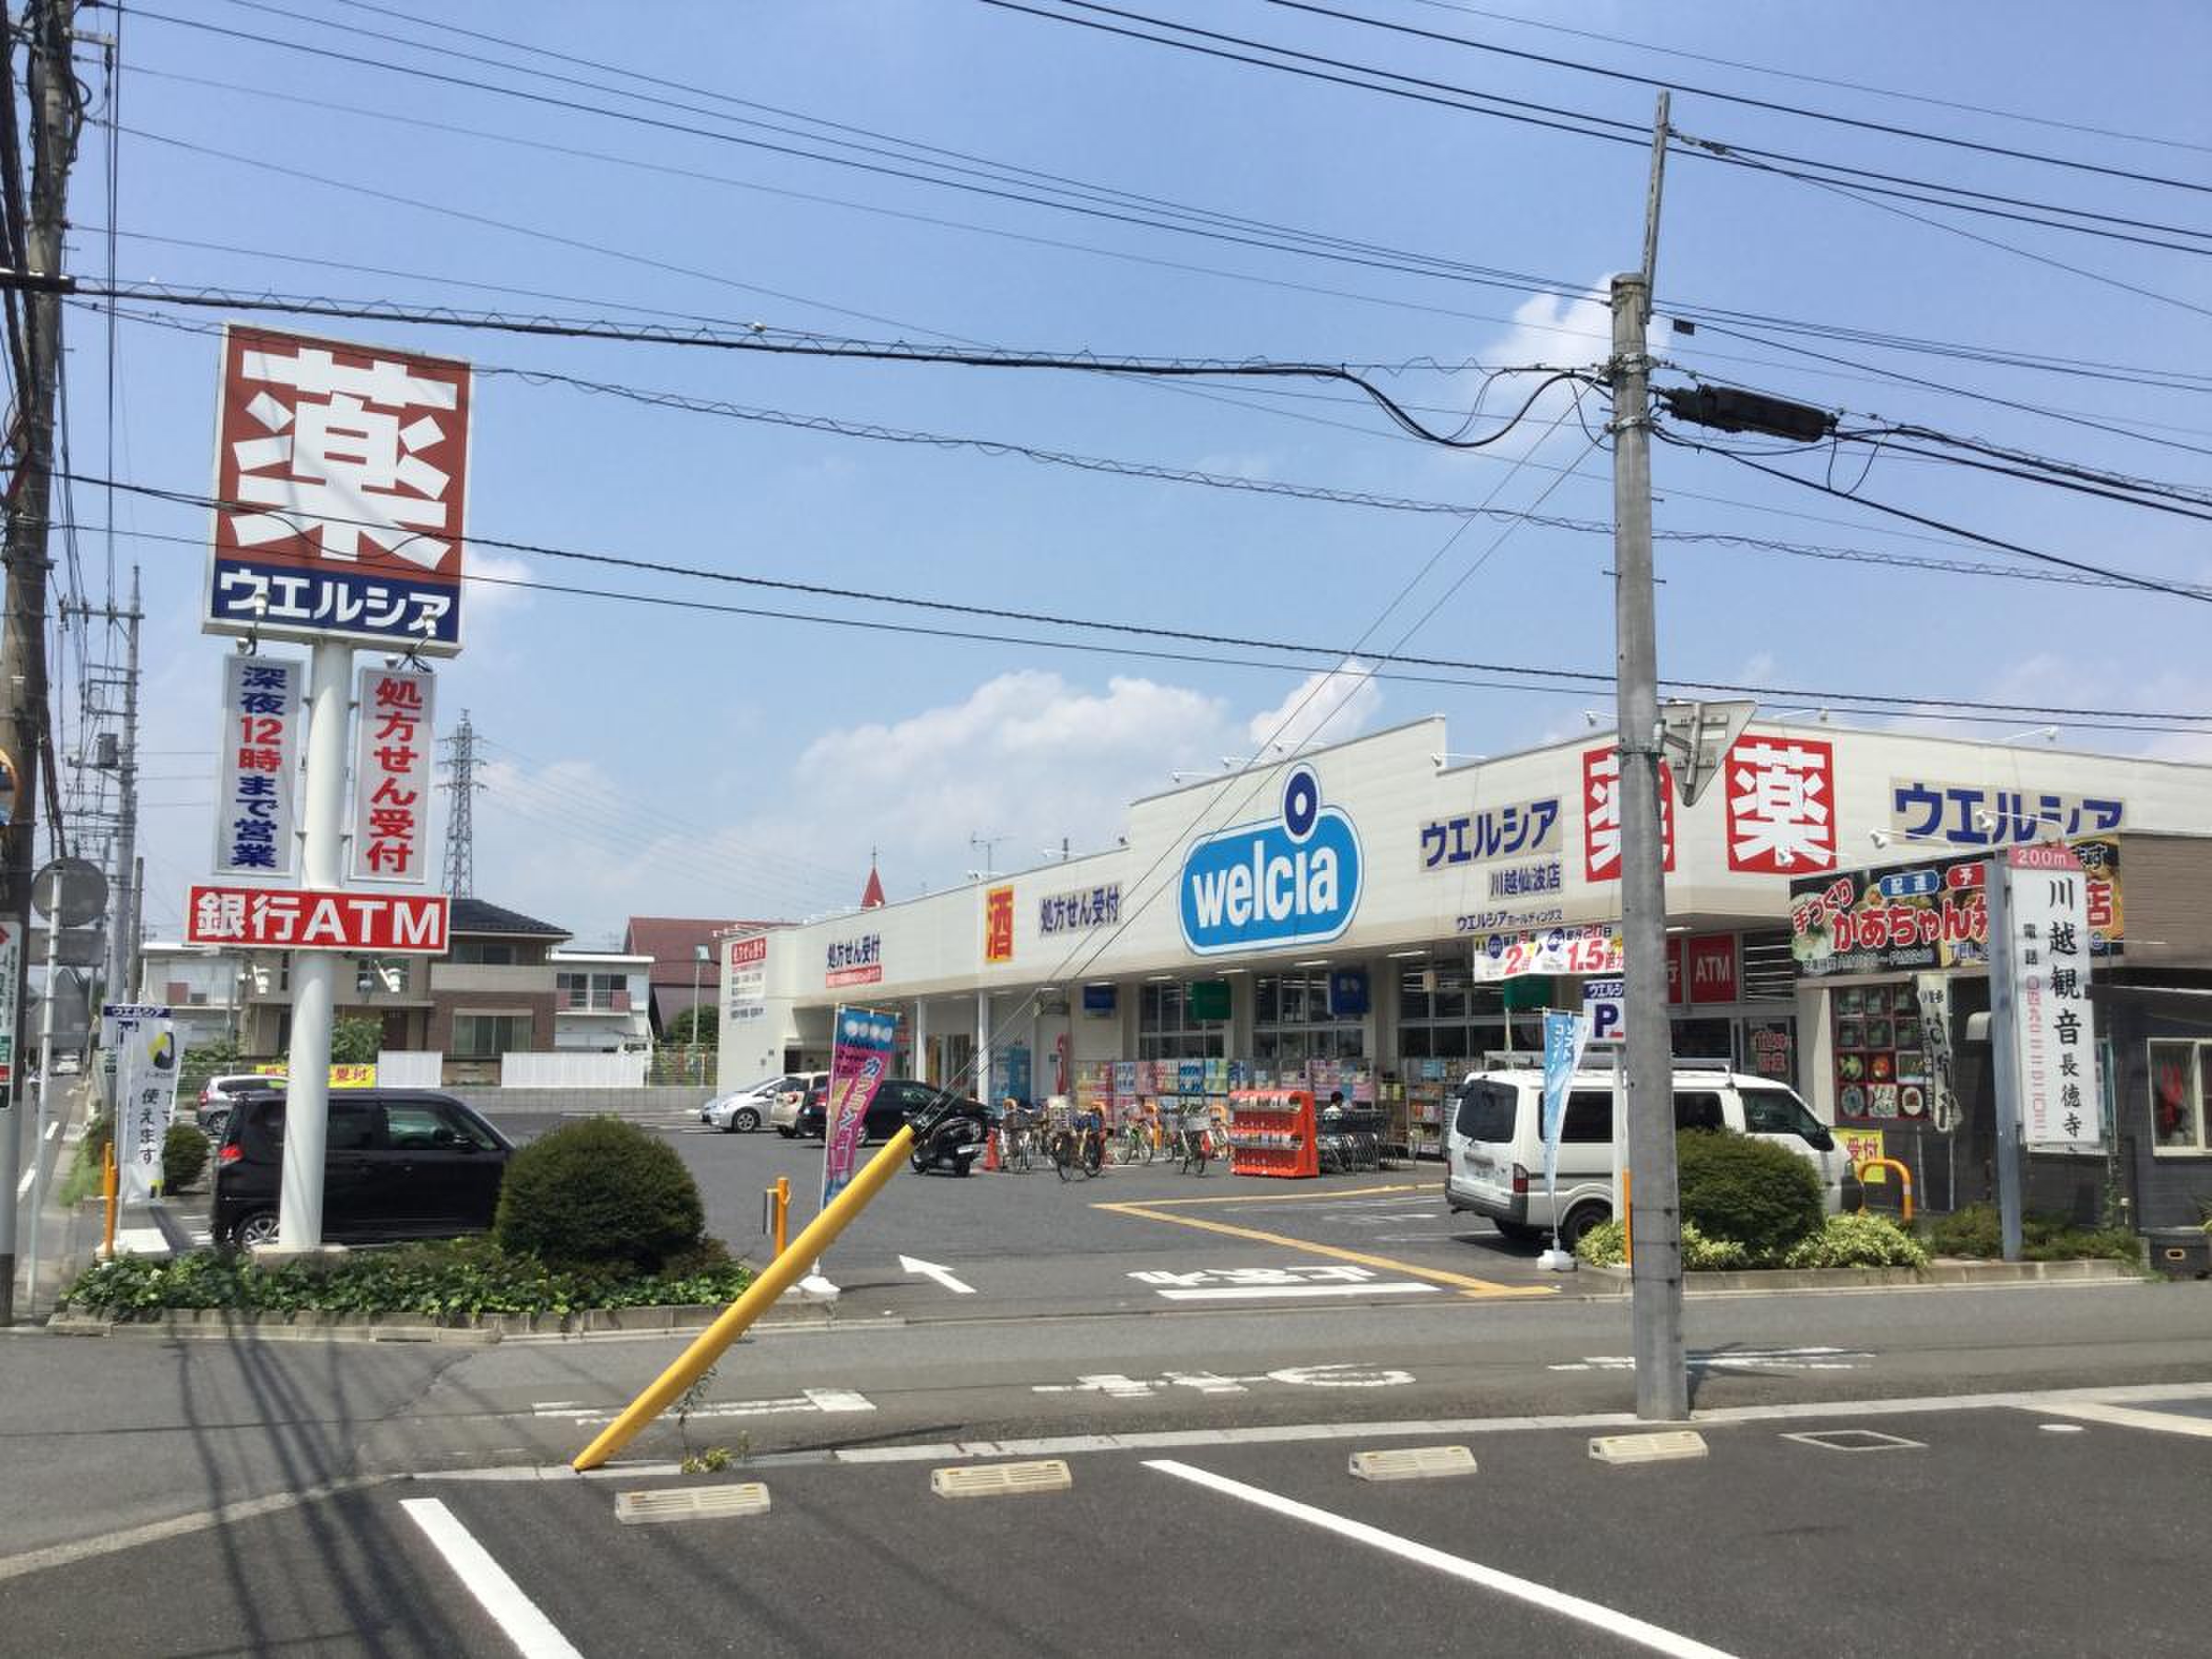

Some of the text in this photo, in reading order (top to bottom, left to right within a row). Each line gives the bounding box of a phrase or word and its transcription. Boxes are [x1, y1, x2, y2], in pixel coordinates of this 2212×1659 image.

[231, 347, 457, 571] 薬
[220, 569, 451, 633] ウエルシア
[231, 665, 287, 868] 深夜12時まで営業
[366, 677, 423, 873] 処方せん受付
[1421, 799, 1559, 867] ウエルシア
[1731, 741, 1830, 867] 薬
[1894, 782, 2123, 845] ウエルシア
[1193, 840, 1339, 929] welcia
[1489, 863, 1561, 896] 川越仙波店
[2018, 849, 2065, 866] 200m
[196, 891, 441, 946] 銀行ATM
[986, 889, 1013, 960] 酒
[1040, 886, 1122, 935] 処方せん受付
[1589, 983, 1623, 998] ウエルシ
[1695, 956, 1731, 983] ATM
[1594, 1004, 1618, 1038] P
